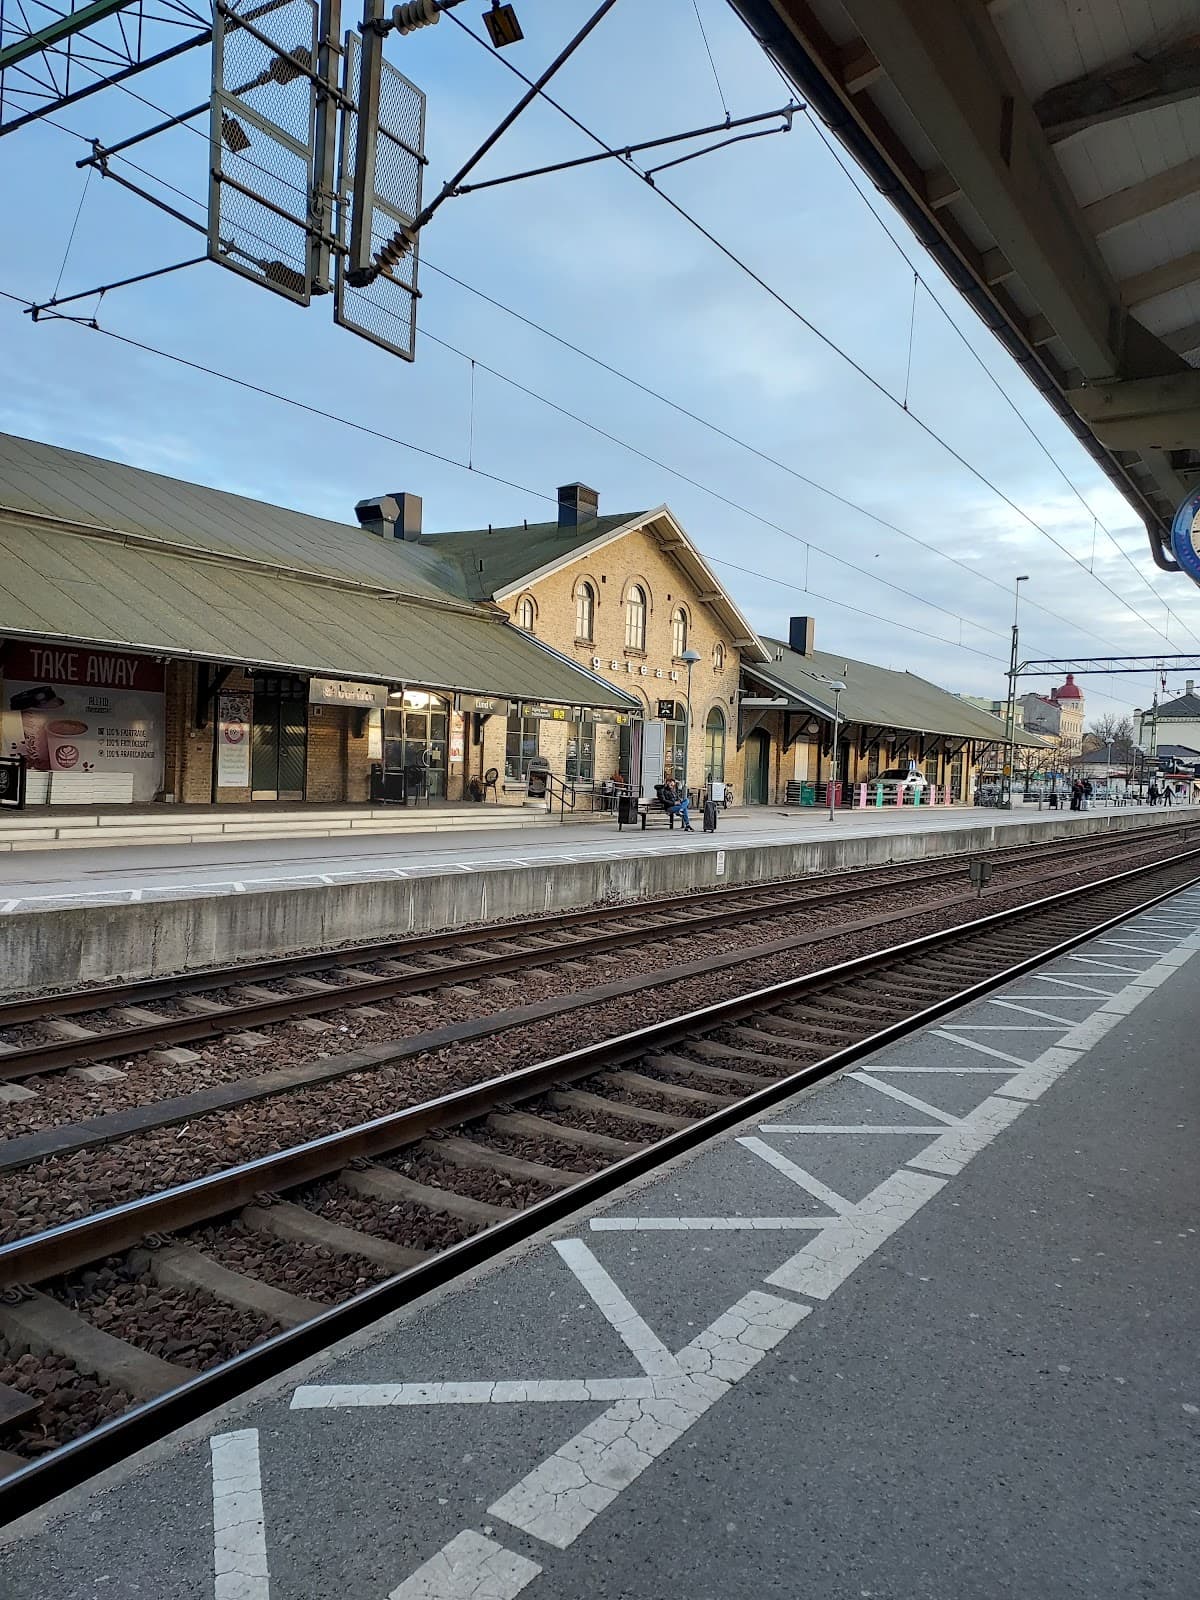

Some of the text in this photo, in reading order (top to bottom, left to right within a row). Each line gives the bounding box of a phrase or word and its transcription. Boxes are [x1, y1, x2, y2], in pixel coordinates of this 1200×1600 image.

[29, 649, 138, 686] TAKE AWAY
[593, 656, 679, 683] gateau
[475, 699, 489, 709] Lund
